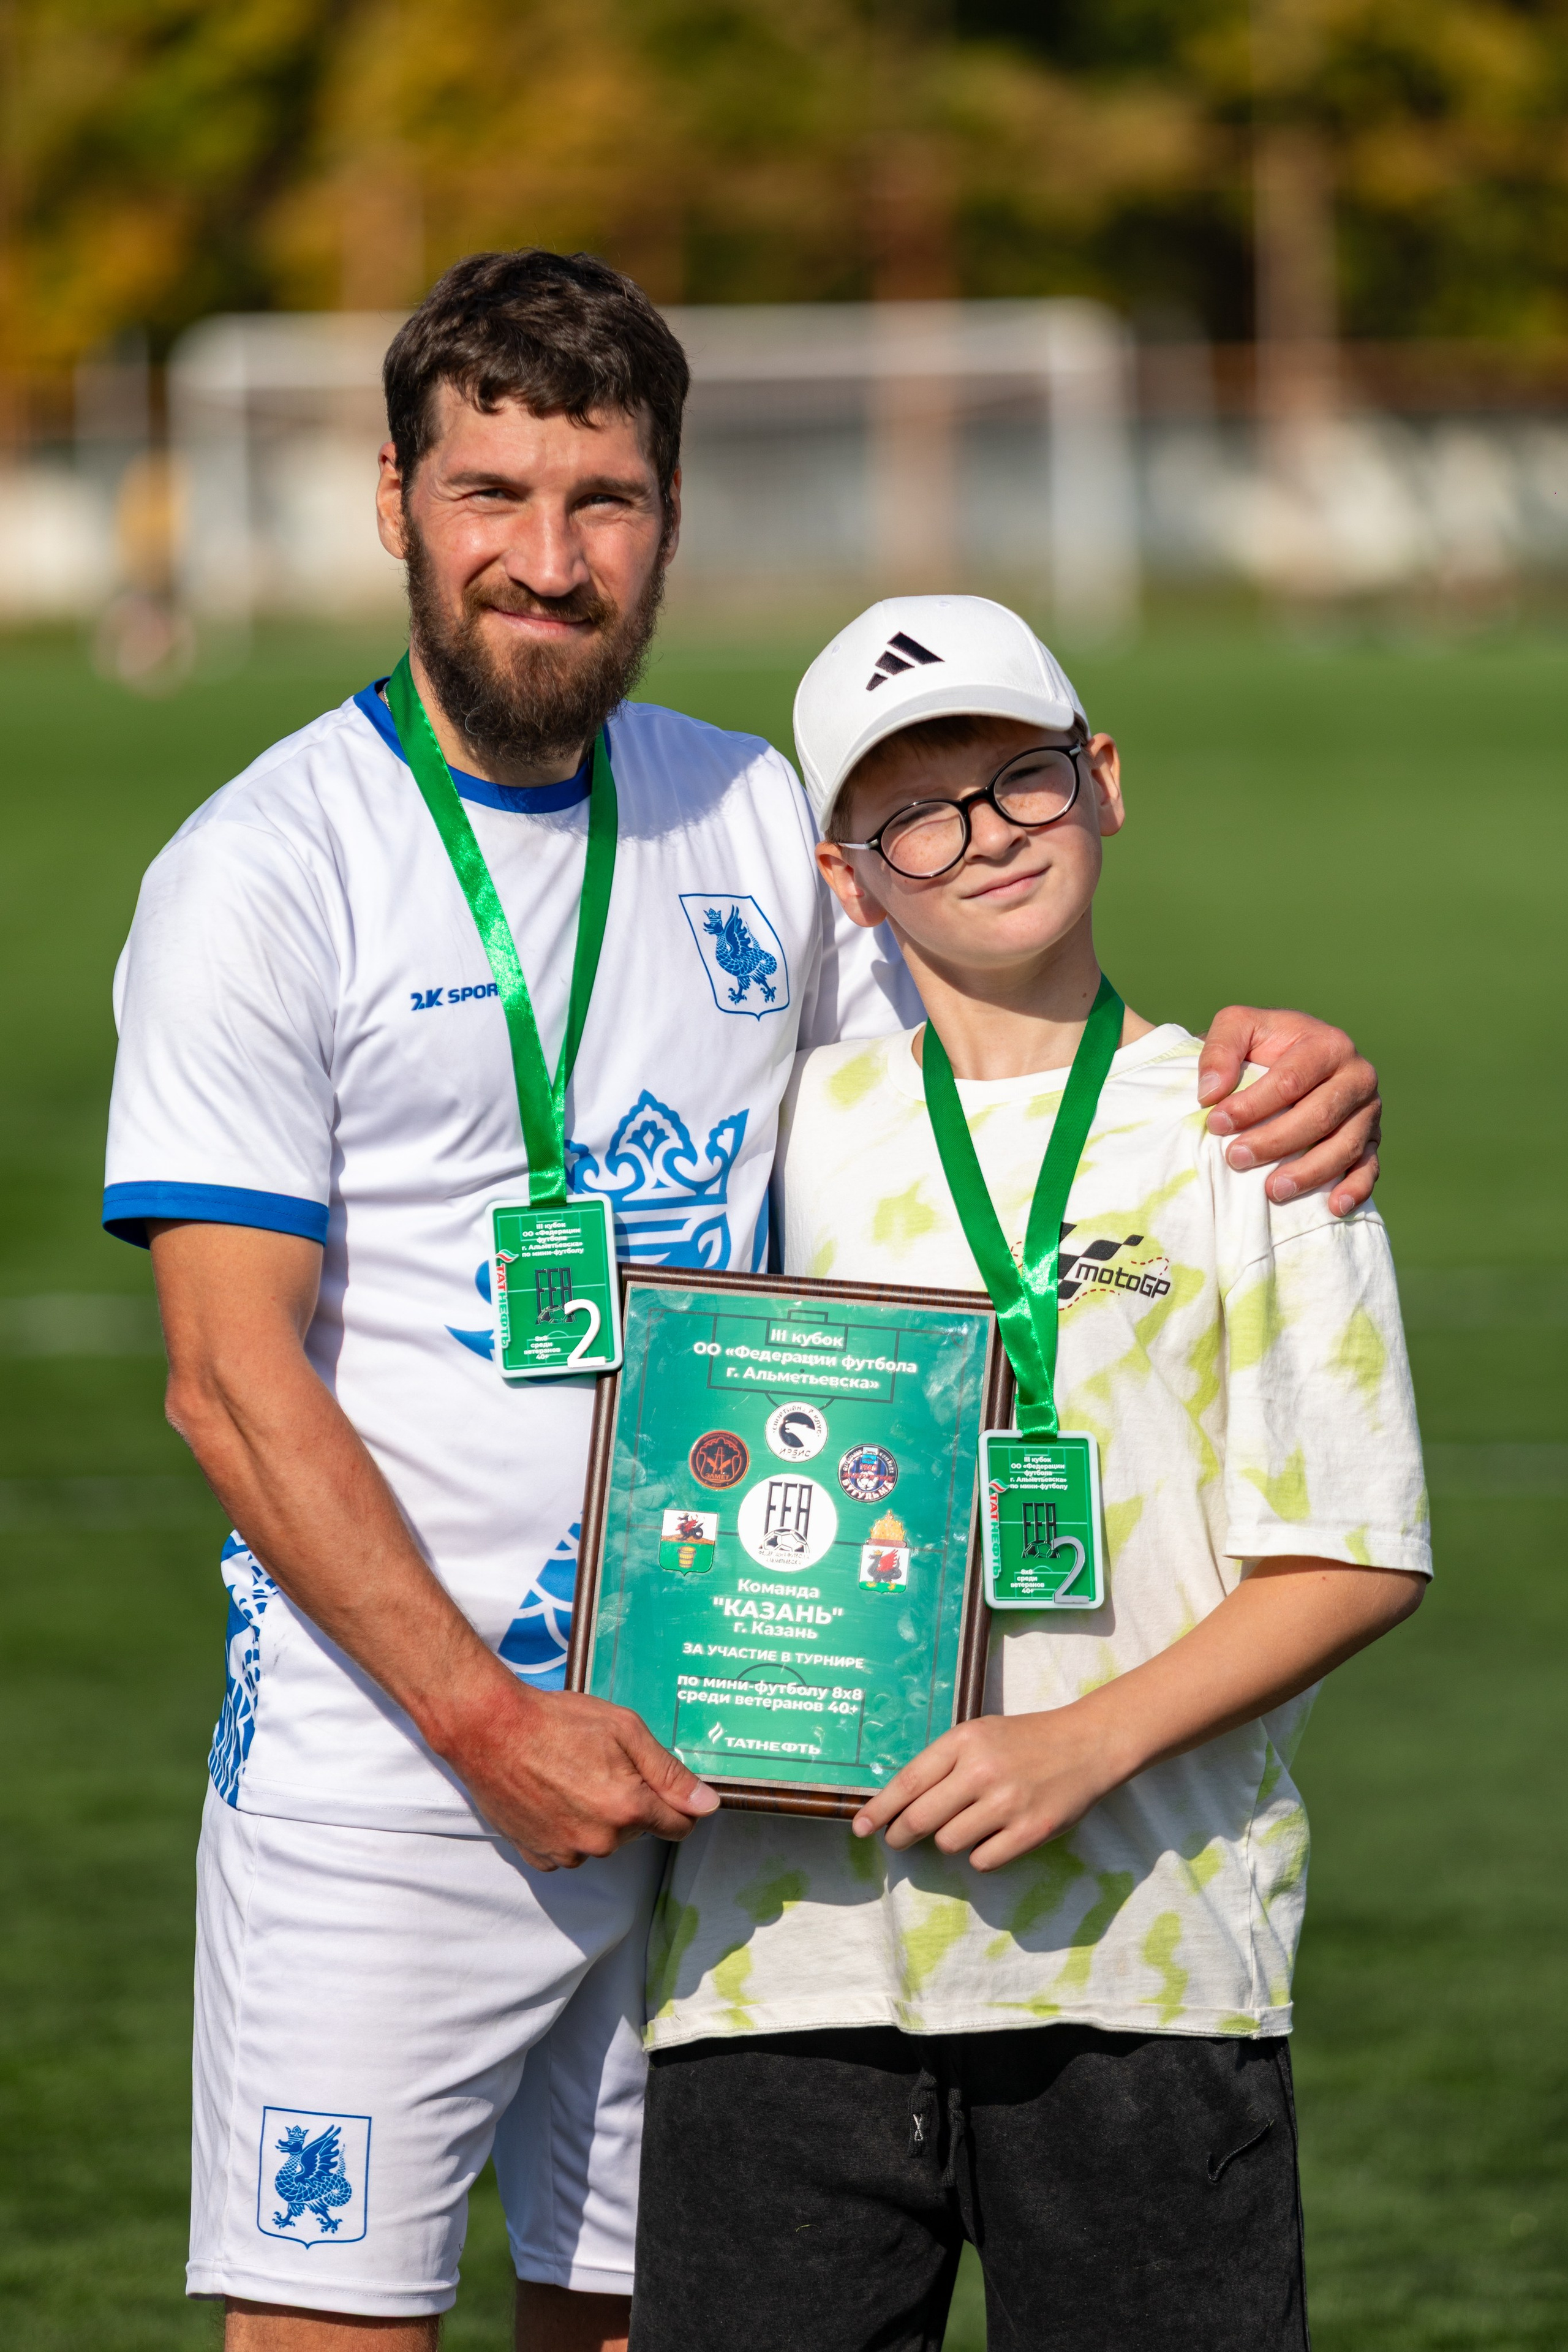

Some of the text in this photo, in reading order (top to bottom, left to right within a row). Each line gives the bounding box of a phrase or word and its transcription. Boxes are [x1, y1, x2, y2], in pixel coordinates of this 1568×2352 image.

[410, 982, 499, 1011] 2K SPOR
[537, 1235, 568, 1243] футбола
[532, 1248, 584, 1256] мини-футболу
[496, 1263, 511, 1349] ТАТНЕФТЬ
[564, 1298, 606, 1368] 2
[771, 1329, 844, 1347] III кубок
[693, 1341, 918, 1373] ОО «Федерации футбола
[726, 1366, 880, 1389] г. Альметьевска»
[842, 1479, 894, 1500] БУГУЛЬМА
[989, 1493, 1002, 1579] ТАТНЕФТЬ
[1052, 1536, 1089, 1603] 2
[737, 1578, 820, 1599] Команда
[713, 1596, 844, 1624] "КАЗАНЬ"
[734, 1621, 818, 1640] г. Казань
[682, 1642, 864, 1669] ЗА УЧАСТИЕ В ТУРНИРЕ
[677, 1675, 699, 1687] по
[703, 1677, 828, 1700] мини-футболу
[677, 1689, 859, 1714] среди ветеранов 40+
[724, 1737, 823, 1755] ТАТНЕФТЬ
